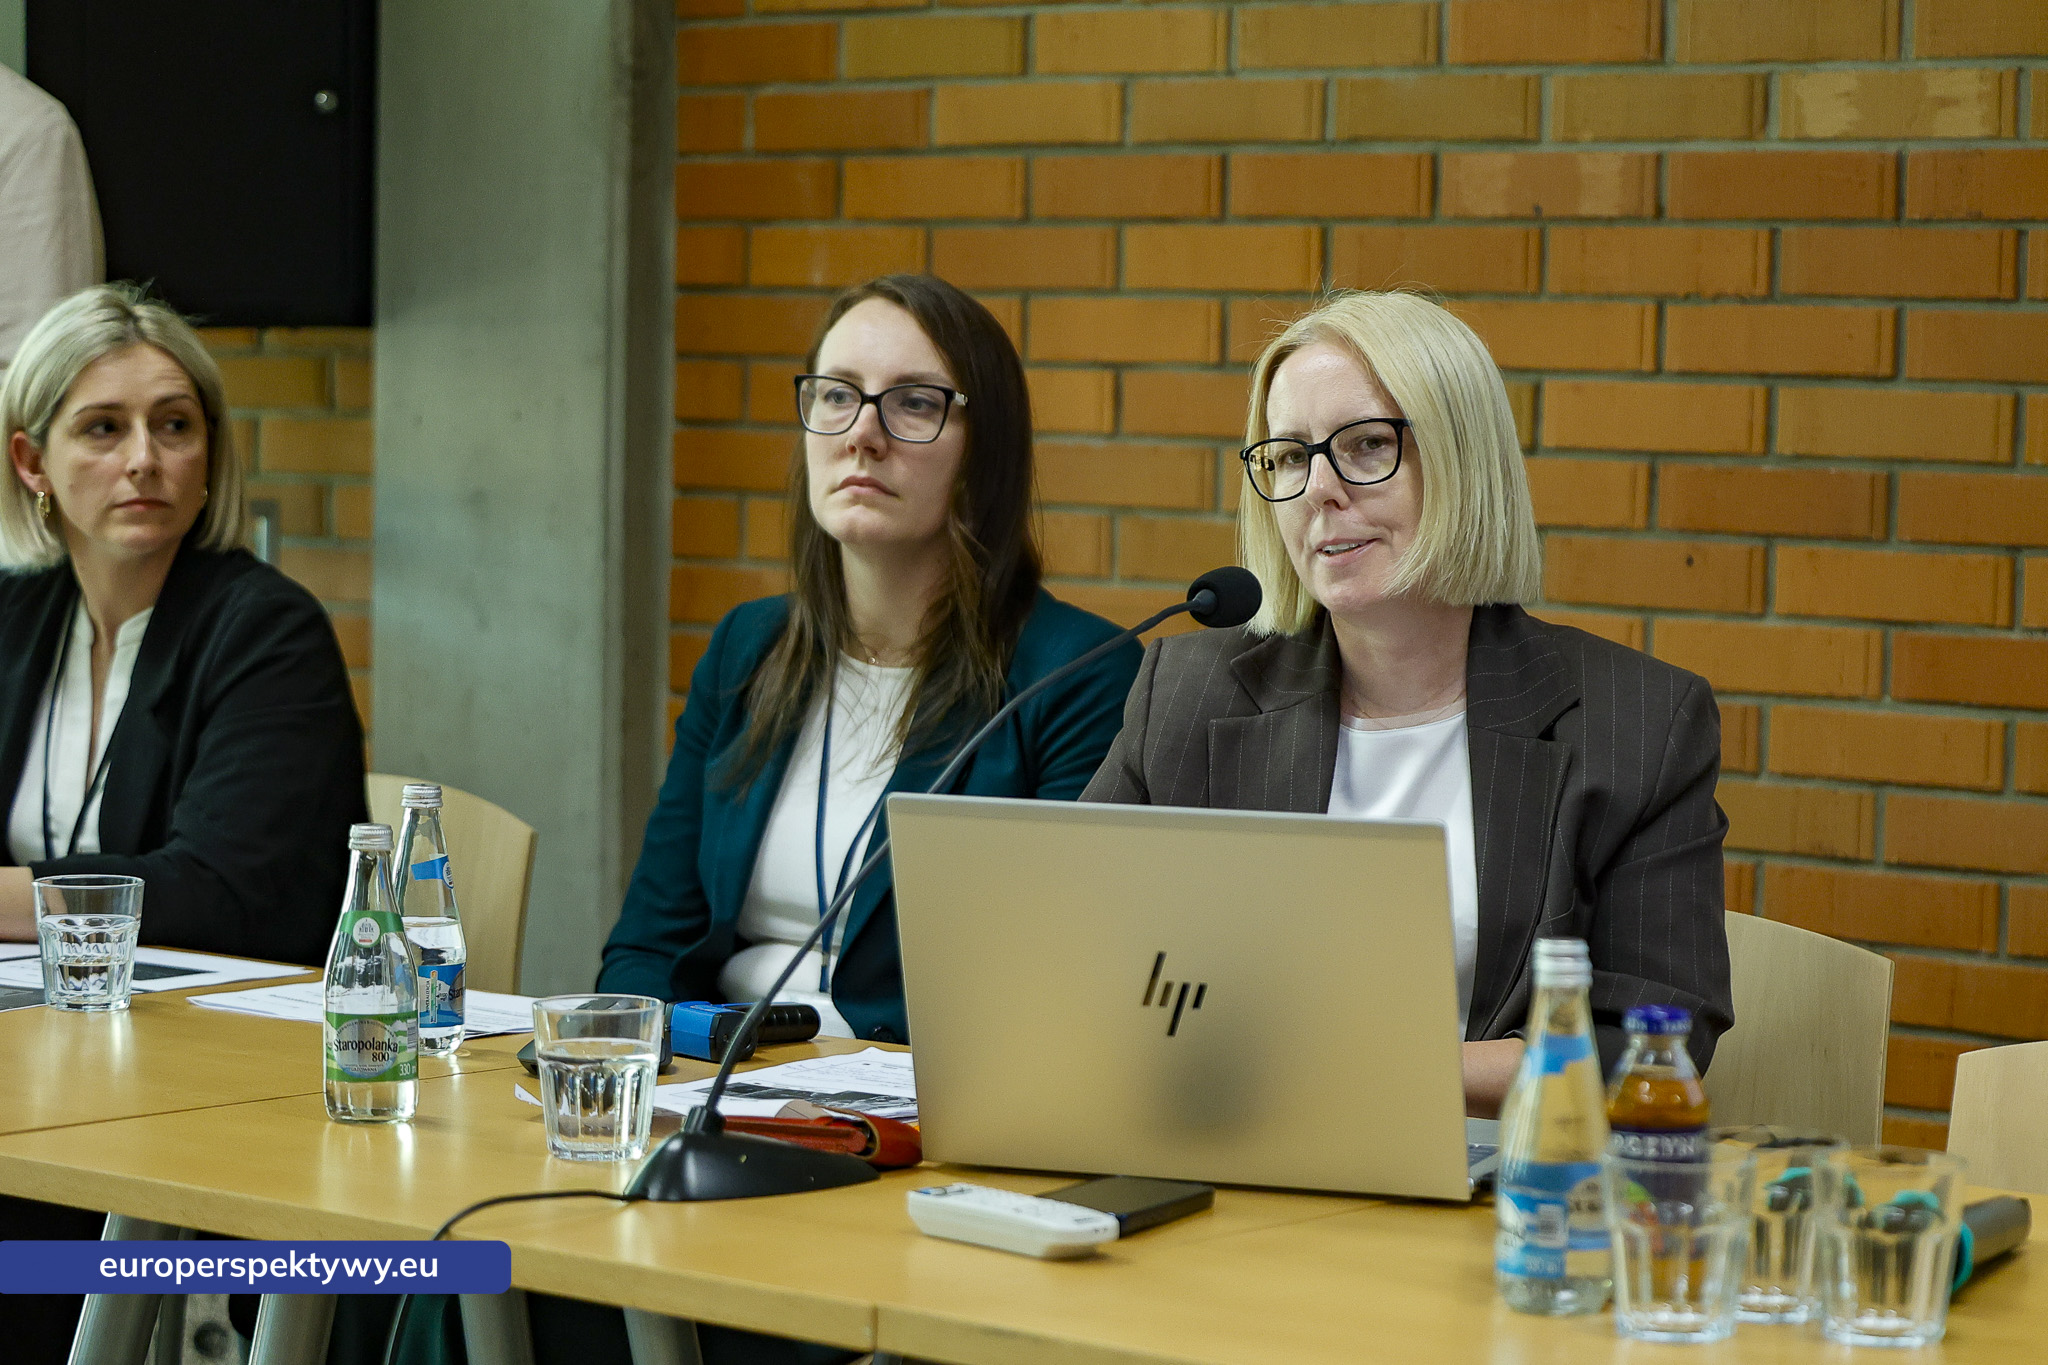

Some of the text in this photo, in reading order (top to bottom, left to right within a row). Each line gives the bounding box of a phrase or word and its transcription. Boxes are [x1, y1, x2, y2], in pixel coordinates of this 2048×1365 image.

[1142, 951, 1209, 1037] hp
[333, 1036, 398, 1053] Staropolanka
[371, 1051, 390, 1063] 800
